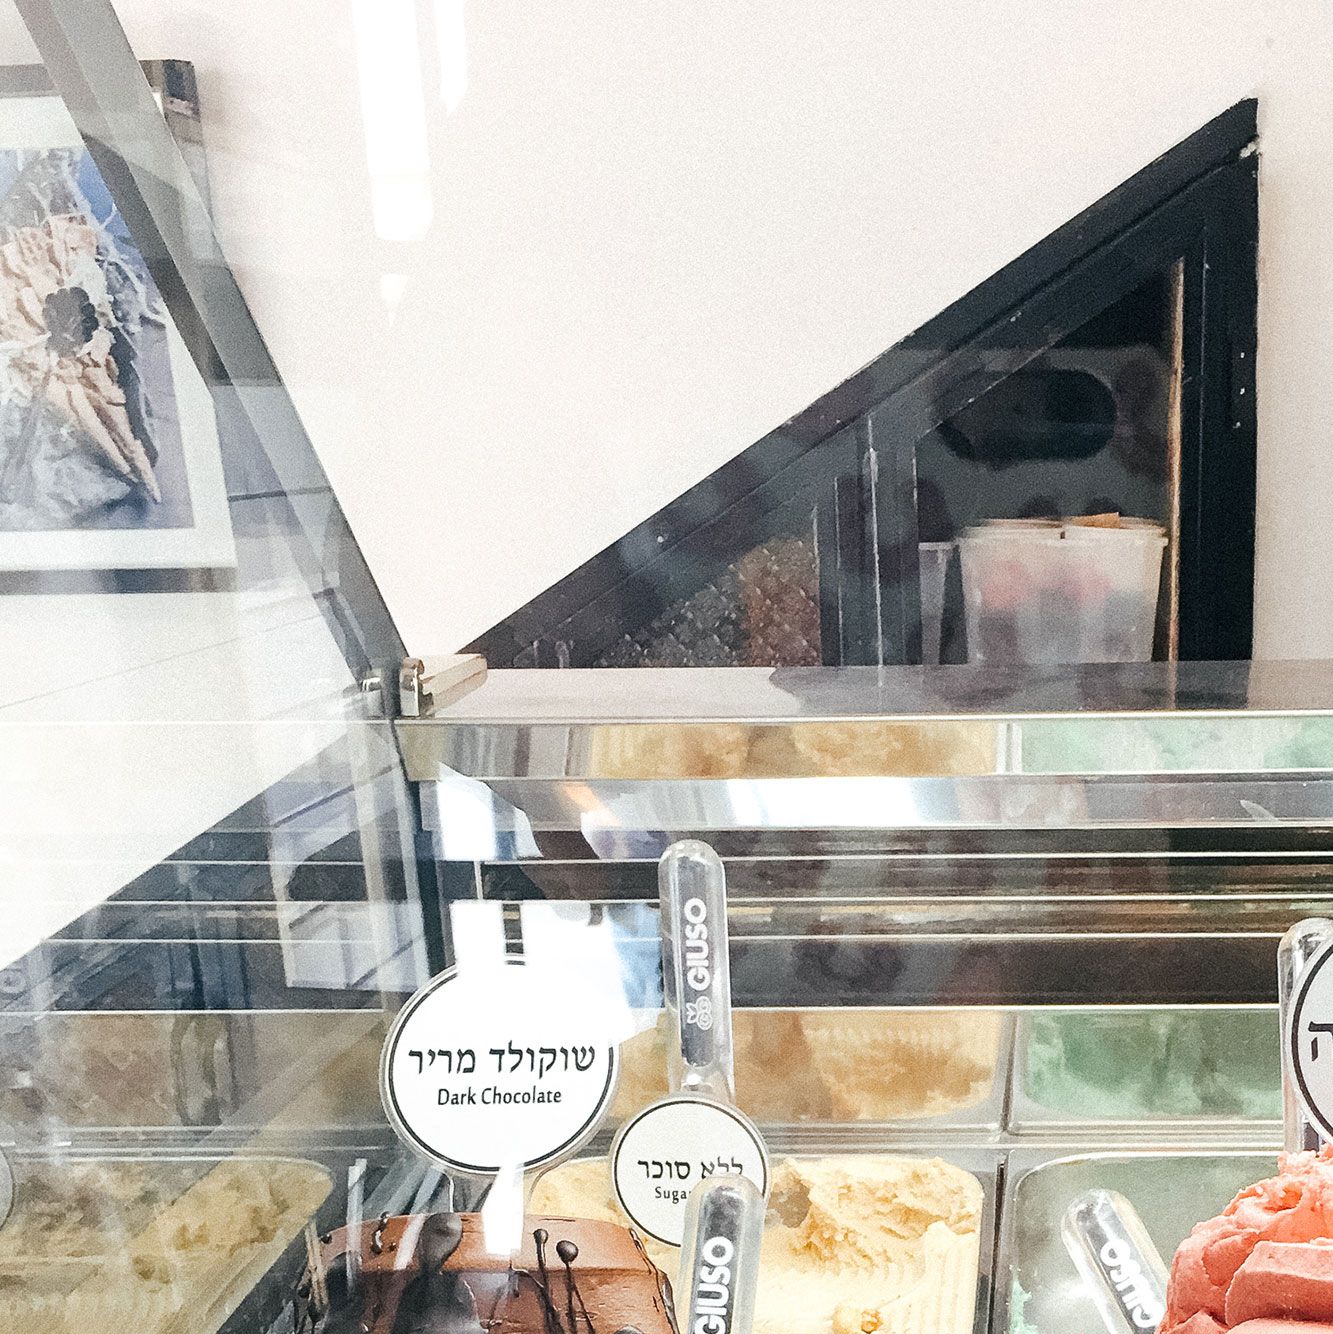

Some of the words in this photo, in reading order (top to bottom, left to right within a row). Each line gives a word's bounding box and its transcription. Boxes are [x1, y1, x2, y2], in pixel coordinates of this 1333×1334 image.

[686, 897, 708, 992] GIUSO
[408, 1049, 476, 1075] מריר
[489, 1040, 596, 1079] שוקולד
[437, 1086, 477, 1106] Dark
[481, 1085, 562, 1104] Chocolate
[637, 1160, 691, 1180] סוכר
[654, 1186, 692, 1205] Suga
